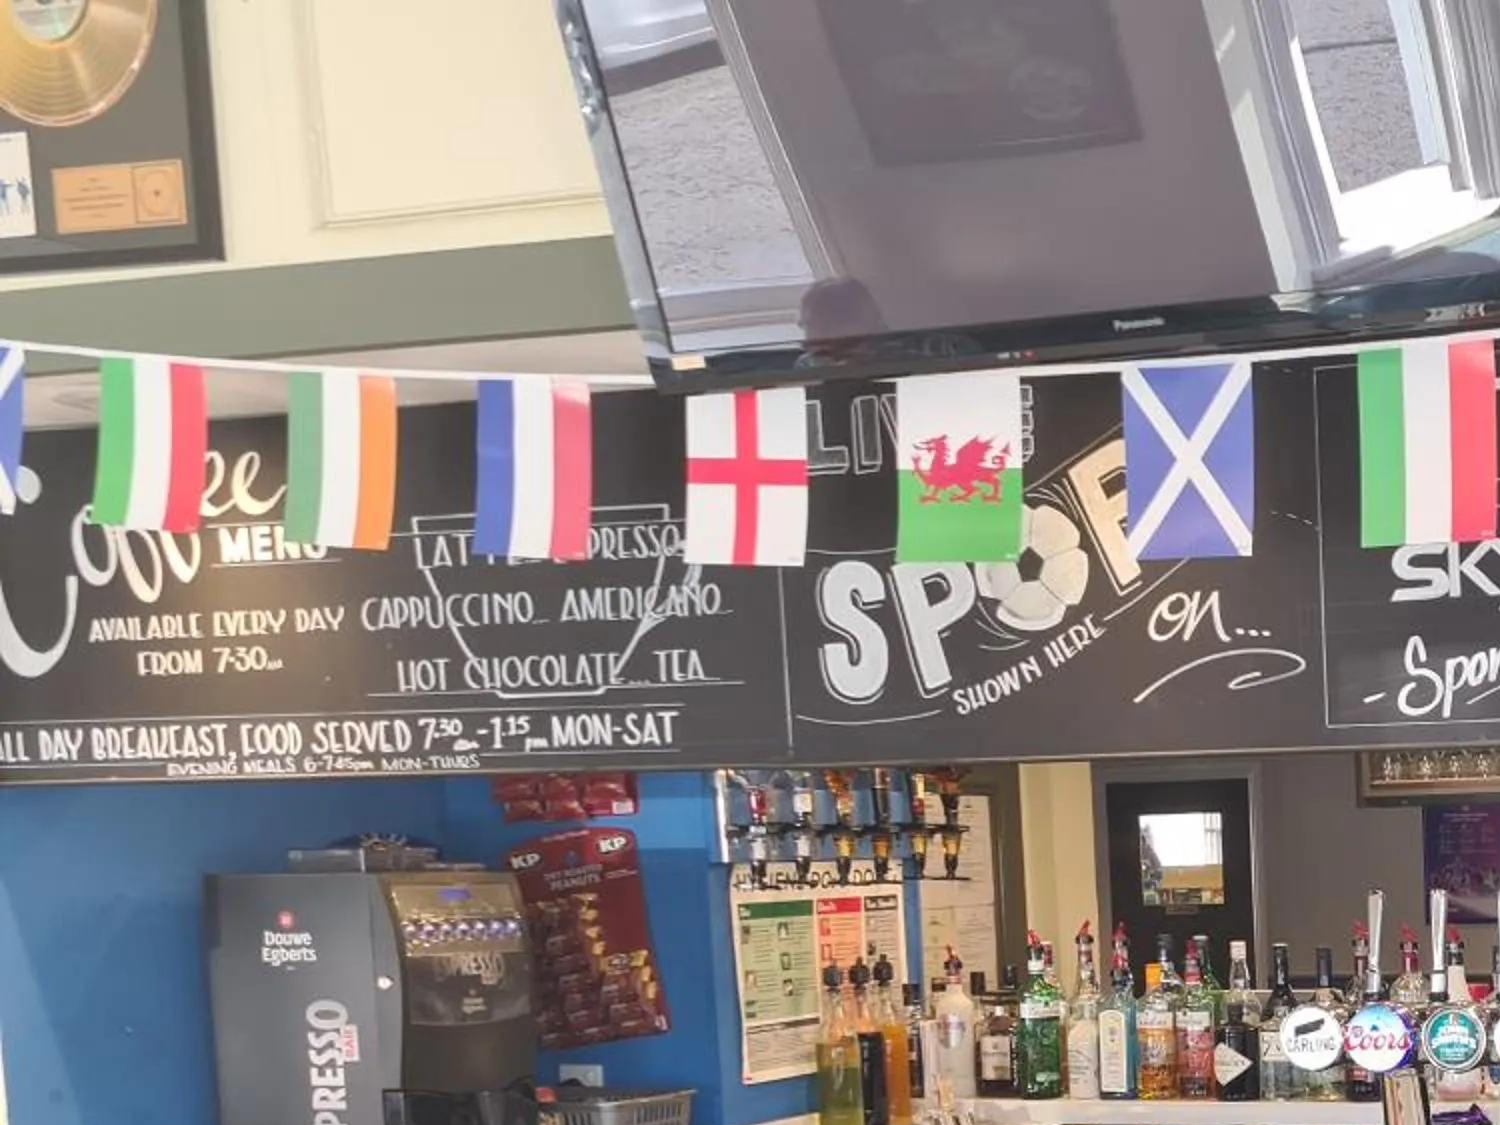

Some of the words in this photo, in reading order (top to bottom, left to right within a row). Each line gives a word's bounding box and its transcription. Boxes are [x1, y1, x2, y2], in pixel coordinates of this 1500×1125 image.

[88, 610, 205, 644] AVAILABLE
[212, 606, 287, 639] EVERY
[294, 603, 346, 634] DAY
[136, 647, 204, 677] FROM
[397, 657, 450, 693] HOT
[952, 659, 1043, 716] SHOWN
[1043, 612, 1109, 669] HERE
[38, 726, 83, 762] DAY
[241, 720, 303, 758] FOOD
[310, 717, 412, 757] SERVED
[243, 757, 297, 774] MEALS
[600, 835, 628, 854] KP
[510, 852, 541, 870] KP
[264, 931, 312, 946] Douwe
[262, 946, 317, 967] Egberts
[1342, 1025, 1413, 1052] Coors
